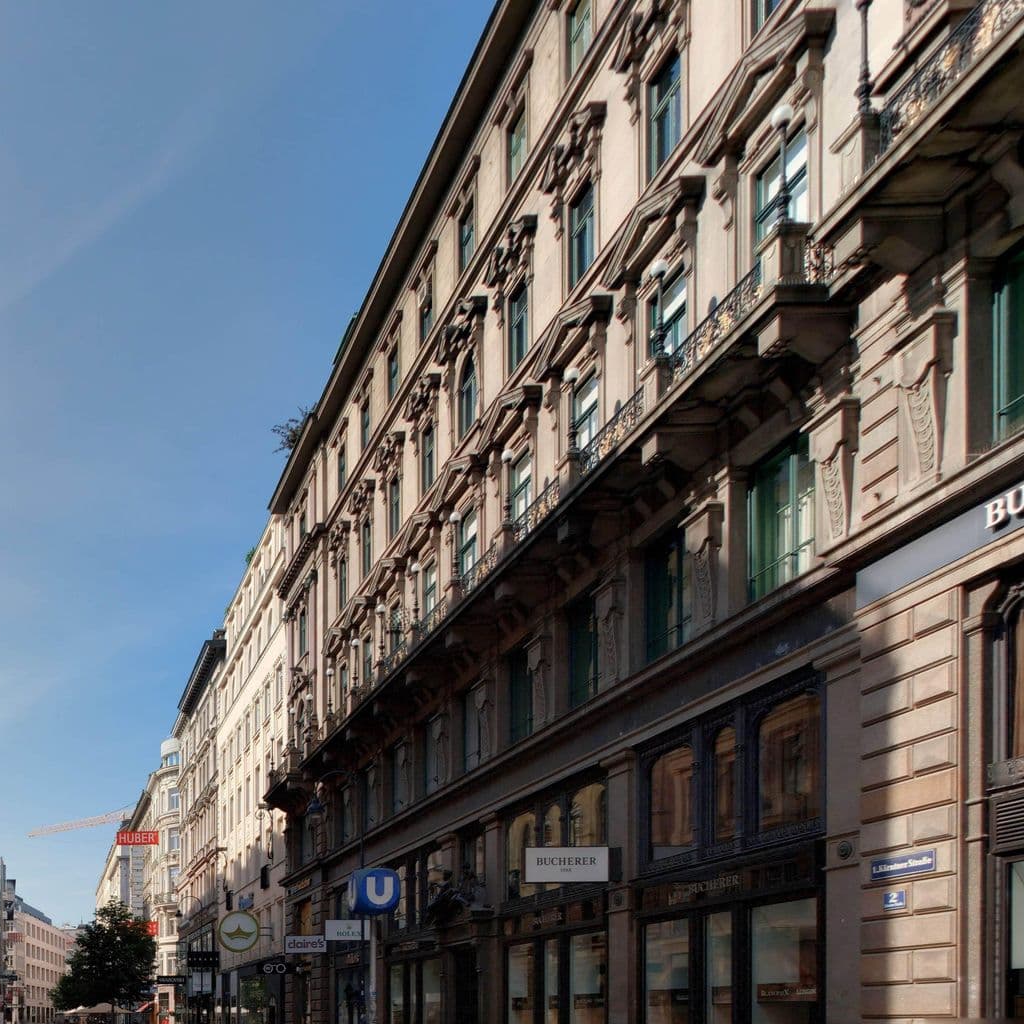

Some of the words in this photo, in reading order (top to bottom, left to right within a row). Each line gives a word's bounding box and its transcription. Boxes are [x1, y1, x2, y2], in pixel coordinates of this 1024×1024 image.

[119, 832, 154, 843] HUBER
[536, 856, 597, 866] BUCHERER
[366, 876, 394, 905] U
[889, 892, 898, 904] 2
[287, 937, 325, 949] claire's
